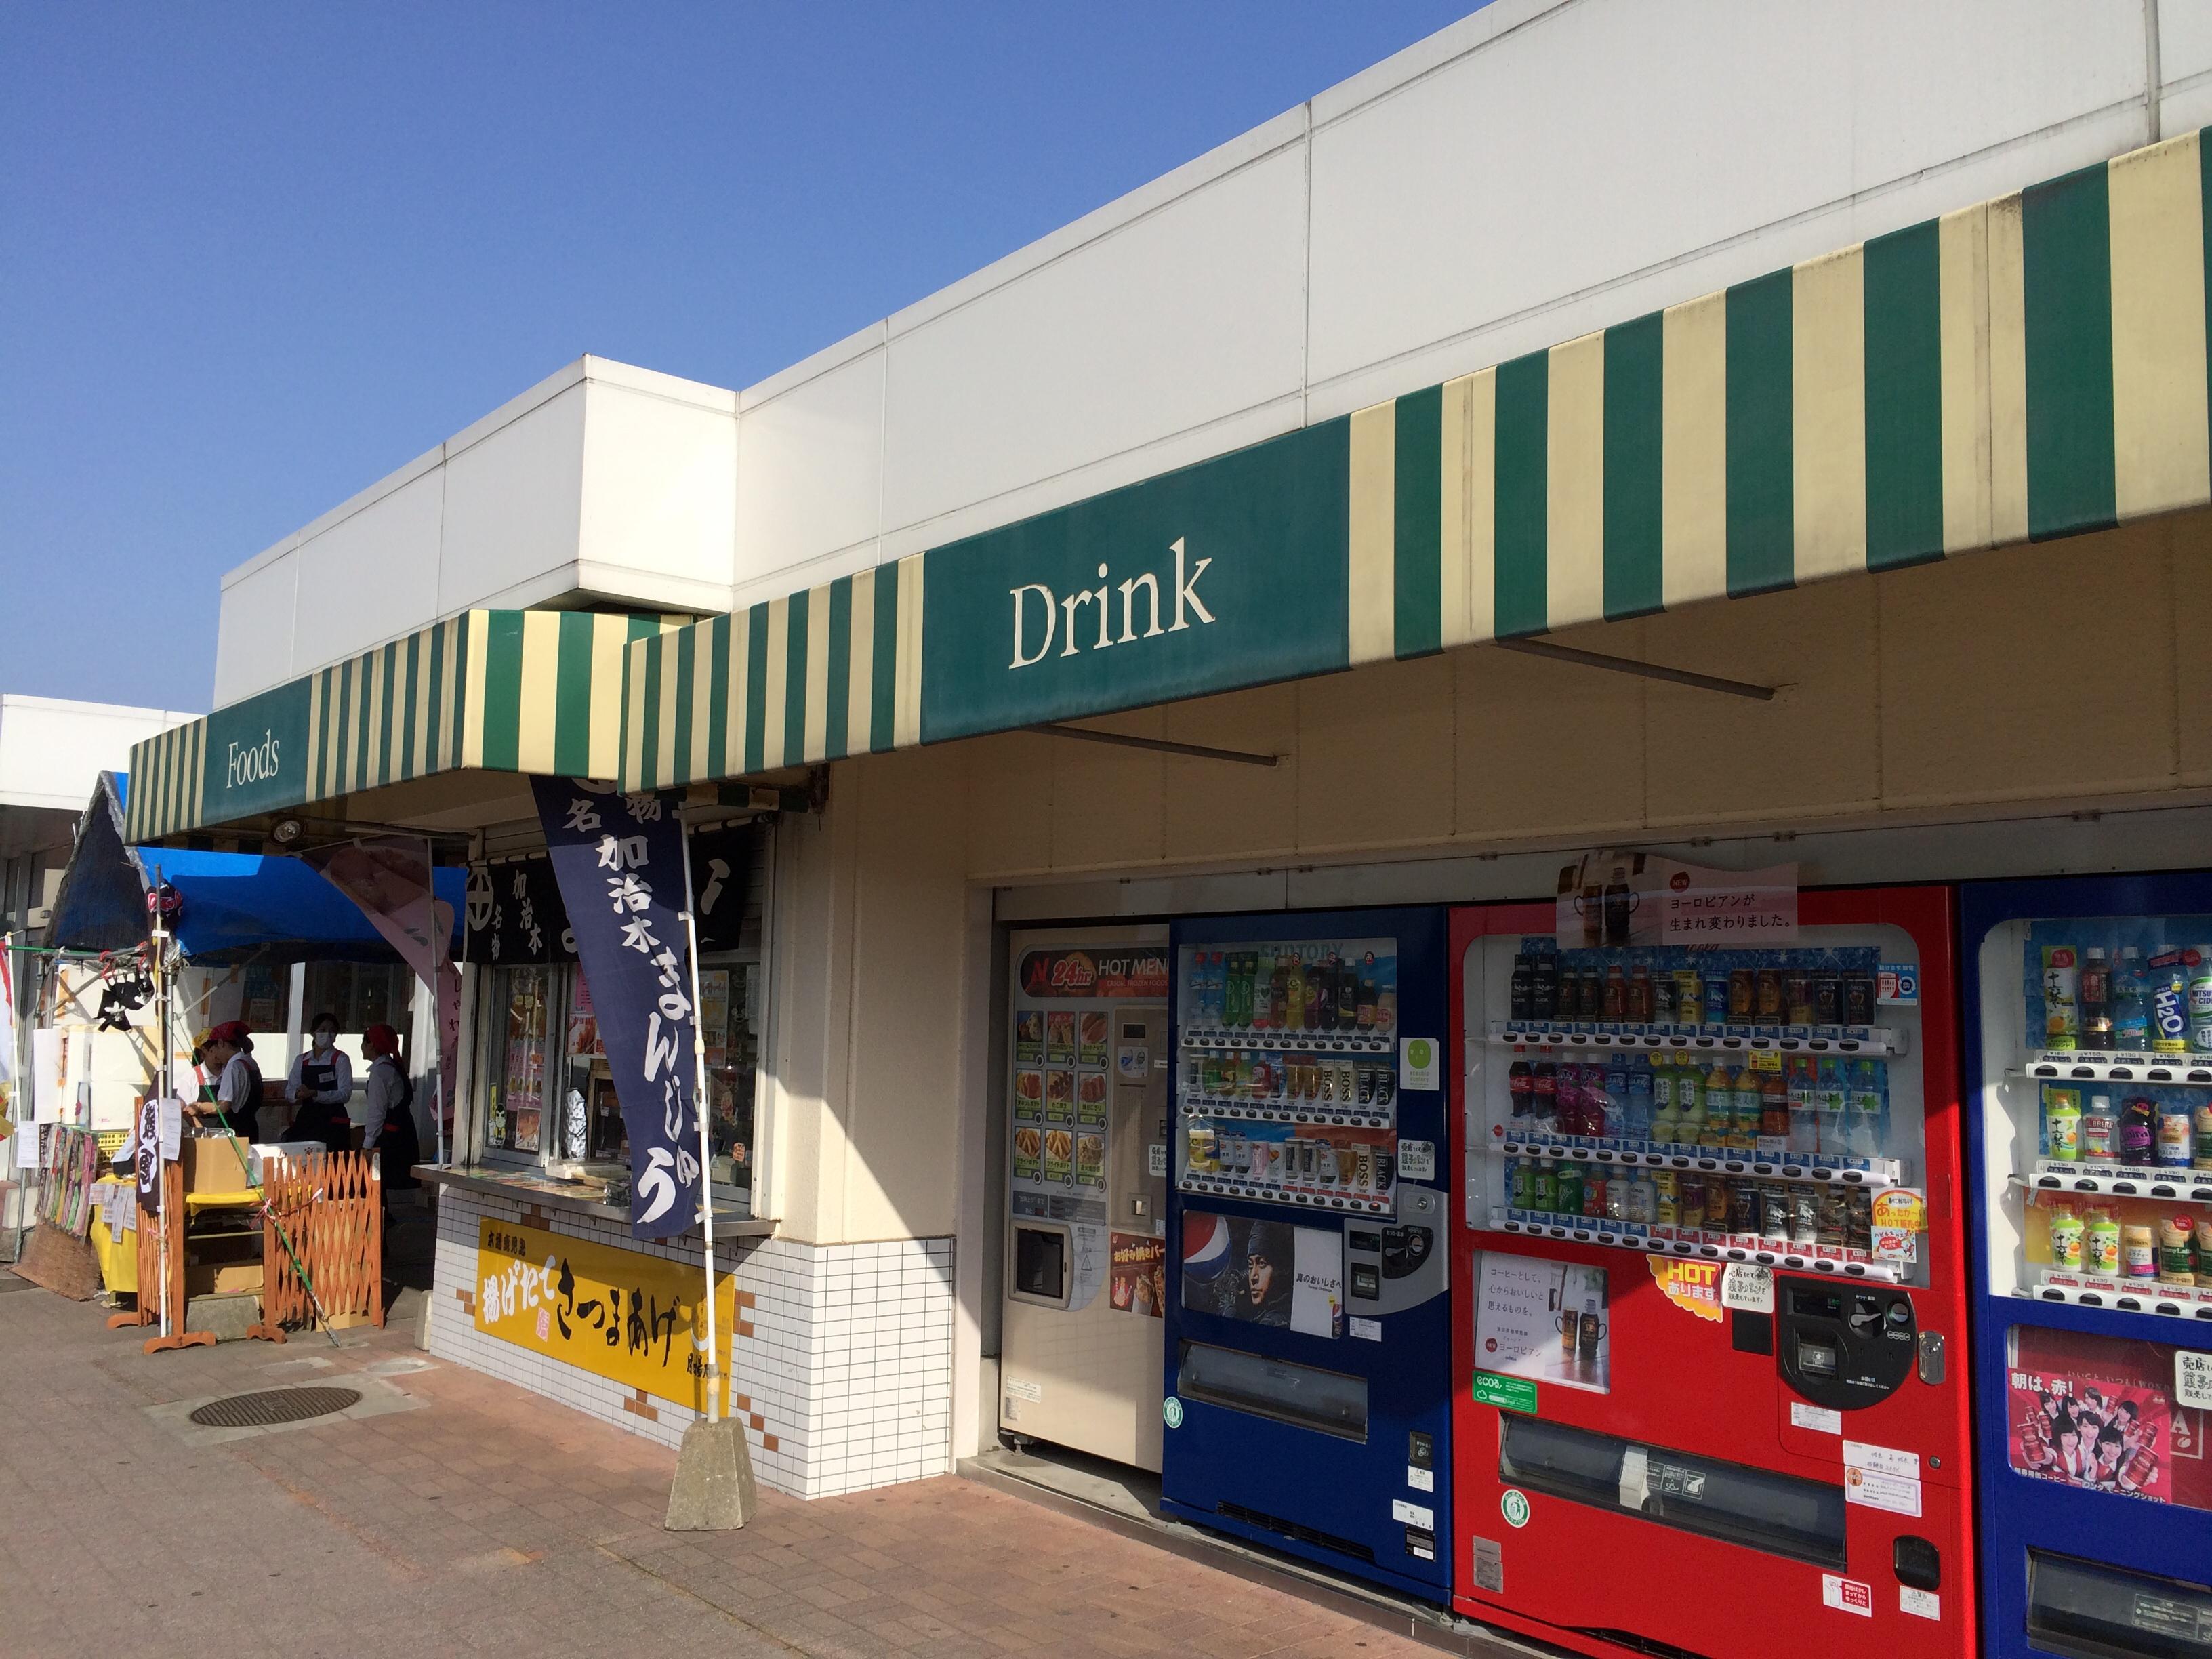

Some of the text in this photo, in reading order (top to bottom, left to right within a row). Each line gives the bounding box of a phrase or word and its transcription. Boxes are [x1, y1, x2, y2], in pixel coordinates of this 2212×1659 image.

[1009, 536, 1216, 670] Drink
[226, 729, 279, 789] Foods
[562, 797, 661, 832] 名物
[512, 869, 543, 955] 加治木
[1671, 893, 1755, 909] ヨーロピアンが
[491, 903, 504, 960] 名物
[1670, 913, 1792, 932] 生まれ変わりました。
[1099, 958, 1169, 977] HOT MEN
[2155, 991, 2184, 1033] H2O
[594, 835, 700, 1223] 加治木まんじゅう
[1323, 1069, 1332, 1101] BOSS
[1341, 1070, 1351, 1102] BOSS
[1359, 1072, 1369, 1105] BLACK
[1378, 1071, 1387, 1106] BLACK
[1358, 1155, 1368, 1187] BOSS
[1377, 1156, 1387, 1191] BLACK
[1296, 1273, 1343, 1289] 真のおいしさへ
[1490, 1268, 1541, 1284] コーヒーとして、
[1667, 1261, 1716, 1285] HOT
[482, 1255, 556, 1325] 揚げたて
[1488, 1284, 1544, 1300] 心からおいしいと
[1668, 1284, 1715, 1301] あります
[557, 1258, 680, 1368] さつまあげ
[1487, 1300, 1532, 1317] 思えるものを、
[1498, 1343, 1542, 1357] ヨーロピアン
[2011, 1372, 2073, 1397] 朝は、赤!
